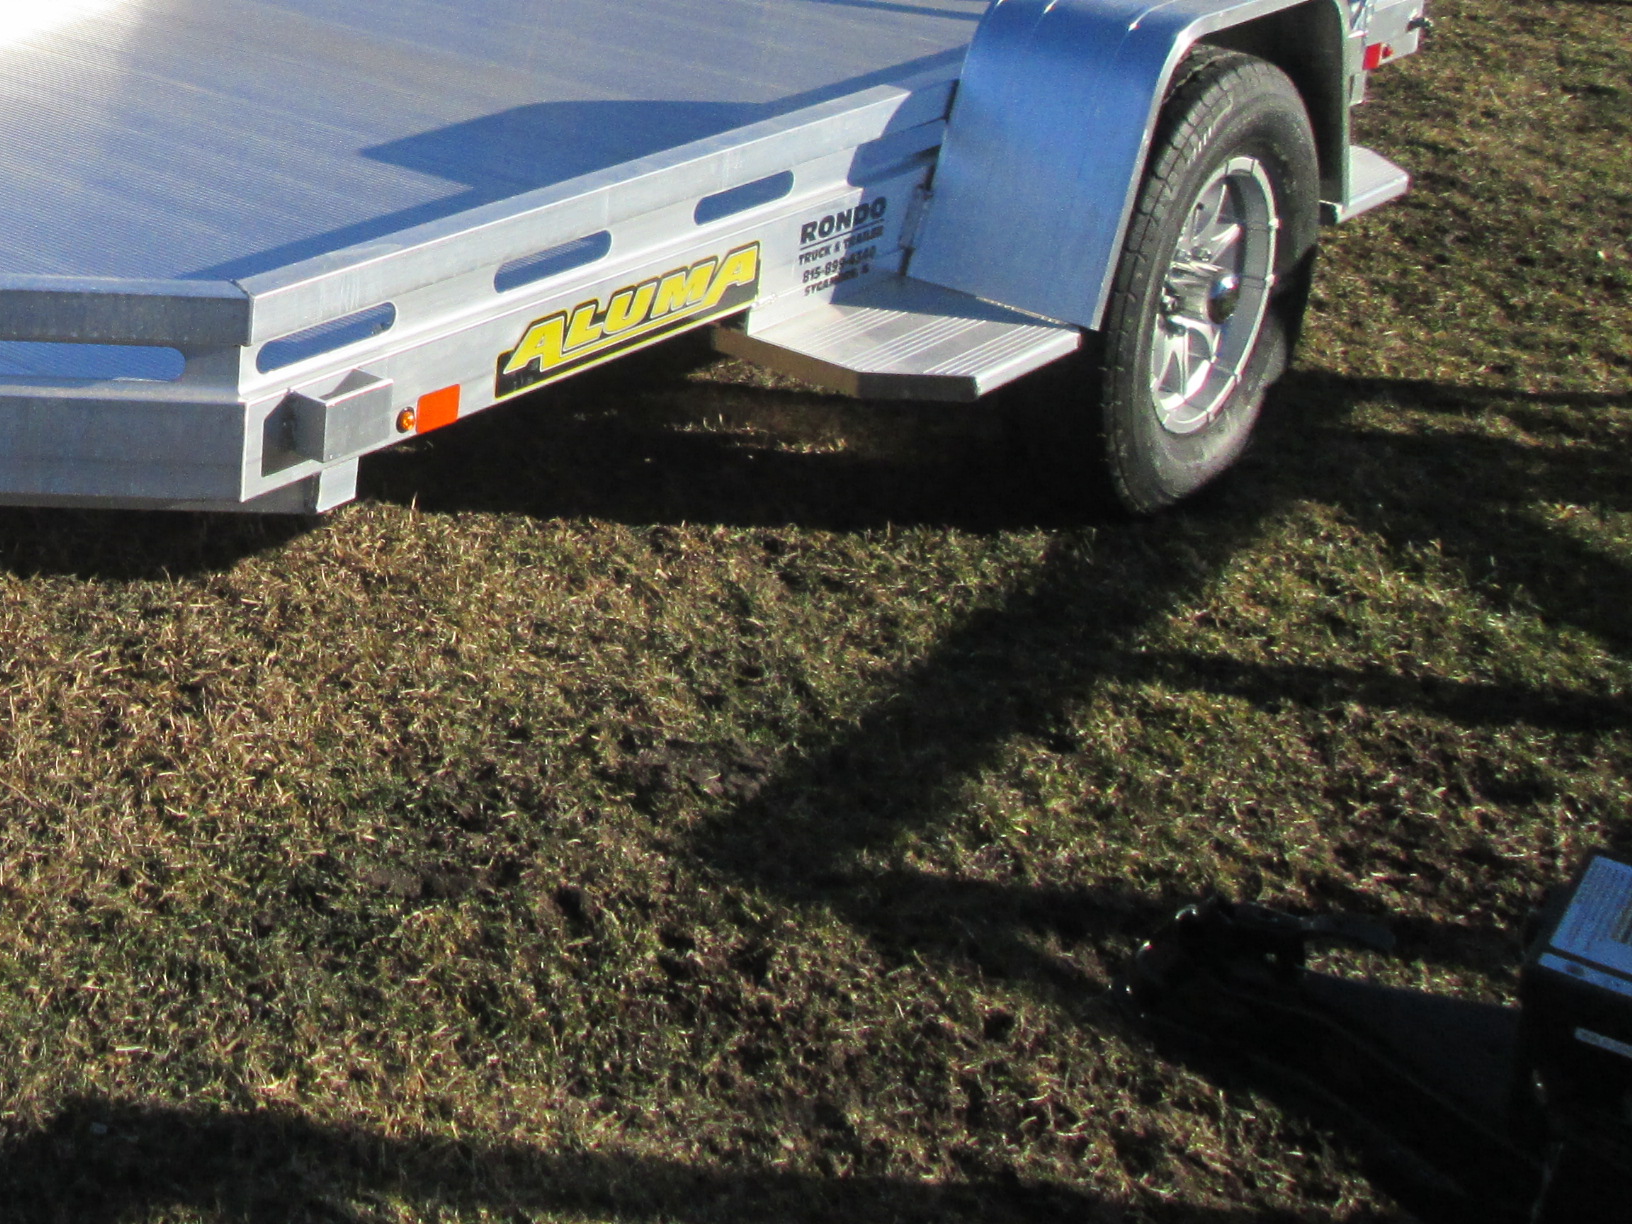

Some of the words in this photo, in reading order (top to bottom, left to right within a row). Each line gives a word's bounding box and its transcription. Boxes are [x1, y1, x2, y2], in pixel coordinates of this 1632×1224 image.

[799, 196, 887, 244] RONDO
[798, 244, 832, 266] TRUCK
[502, 244, 759, 375] ALUMA
